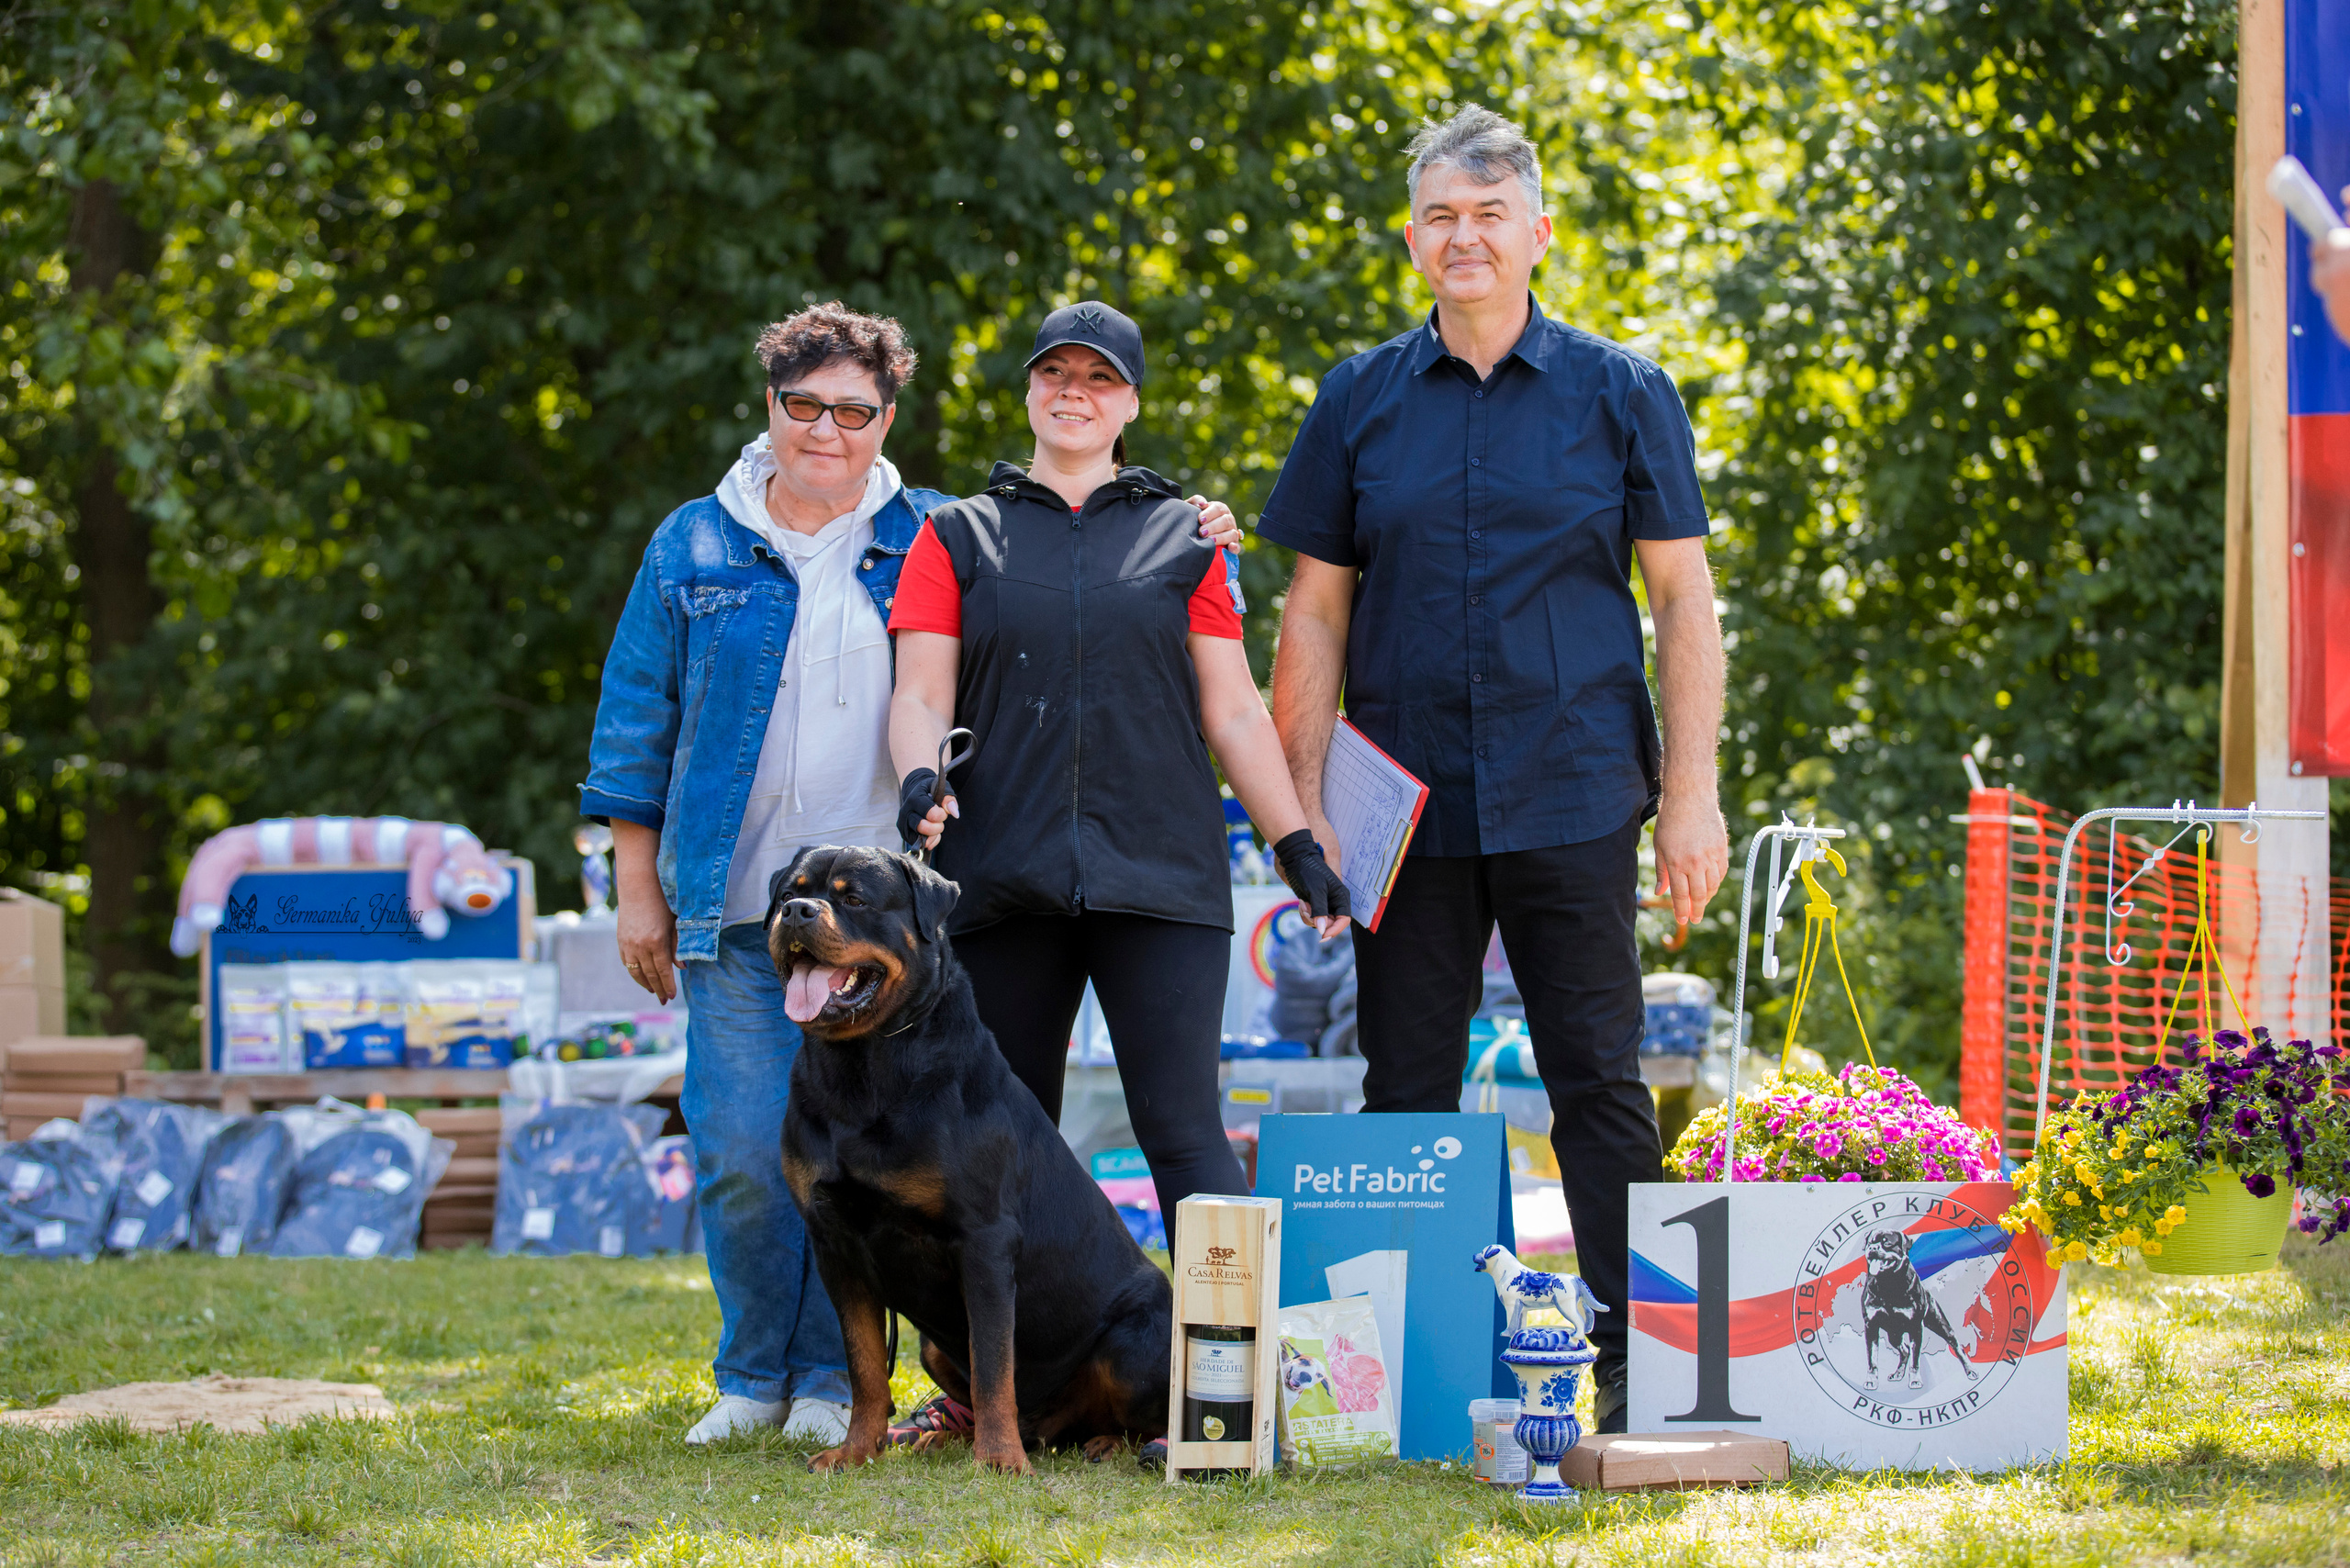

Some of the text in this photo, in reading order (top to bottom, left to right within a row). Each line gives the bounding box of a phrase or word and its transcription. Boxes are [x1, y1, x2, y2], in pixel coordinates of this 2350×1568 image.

[1293, 1161, 1447, 1193] Pet Fabric
[1292, 1199, 1445, 1211] умная забота о ваших питомцах
[1188, 1266, 1253, 1280] CASA RELVAS
[1797, 1196, 2030, 1367] РОТВЕЙЛЕР КЛУБ РОССИИ
[1661, 1195, 1762, 1423] 1
[1200, 1357, 1225, 1365] HERDADE
[1206, 1363, 1245, 1373] MIGUEL
[1852, 1390, 1980, 1426] РКФ-НКПР
[1302, 1417, 1354, 1429] STATERA
